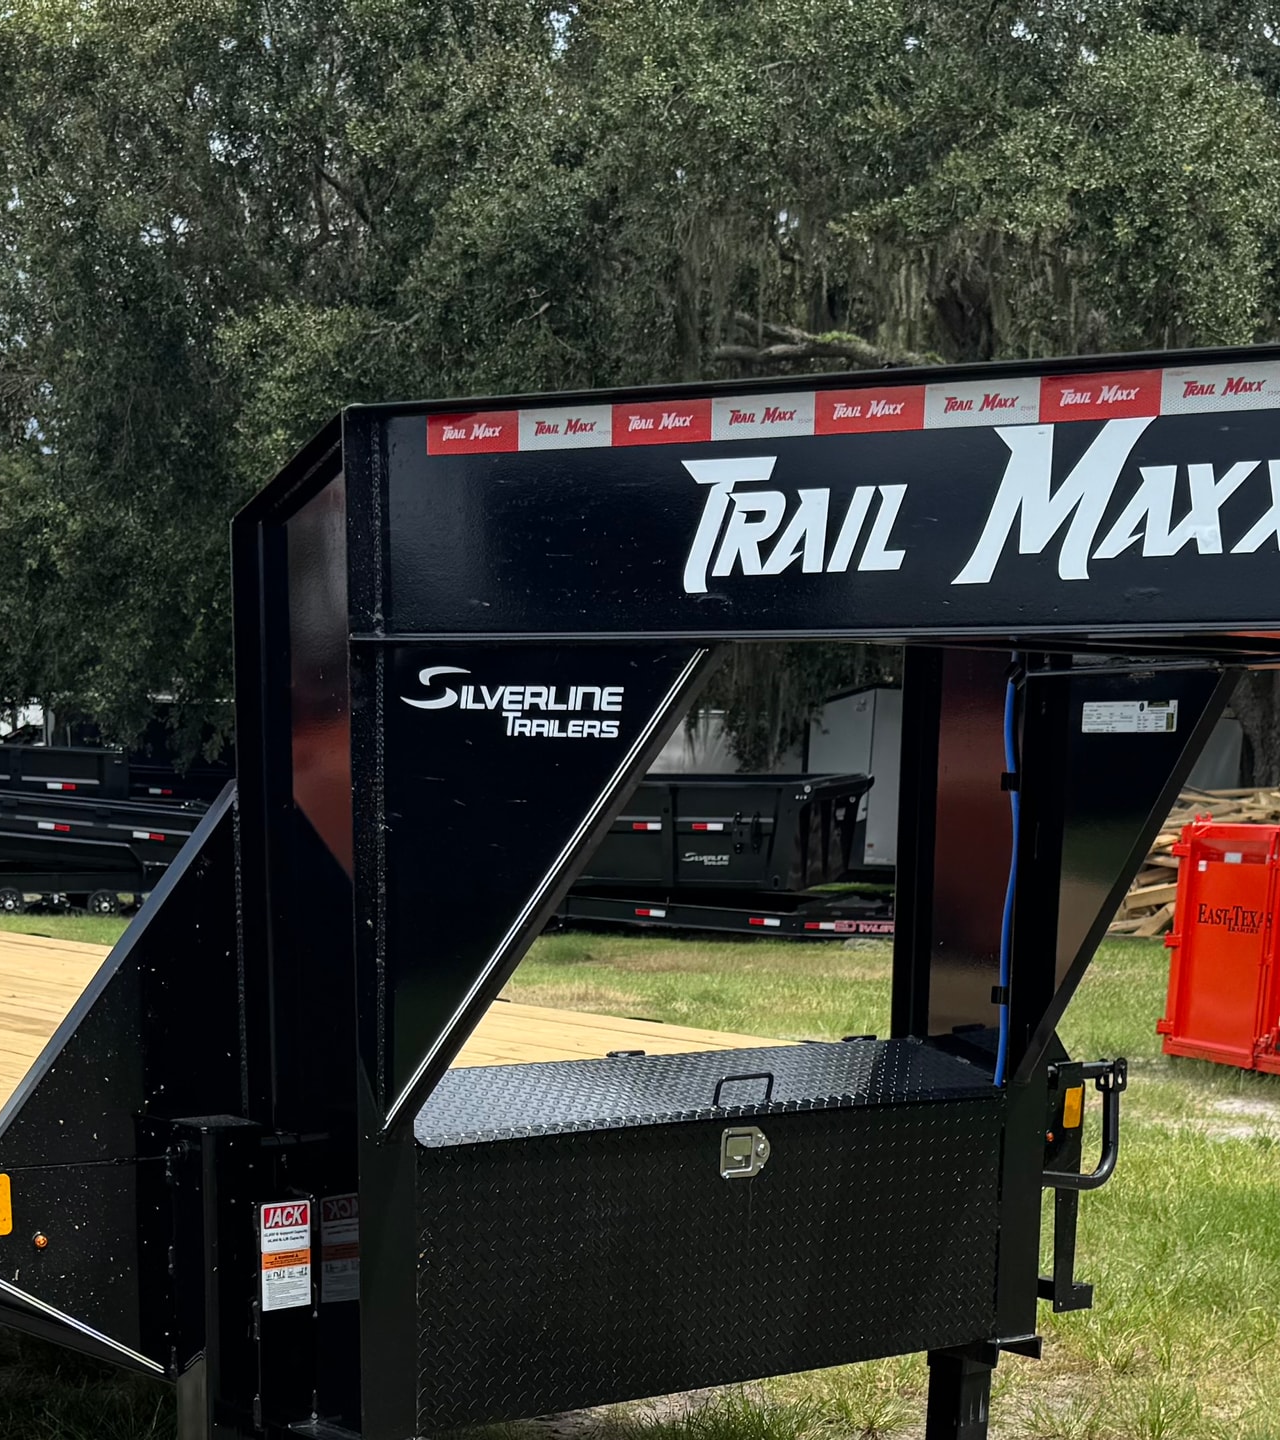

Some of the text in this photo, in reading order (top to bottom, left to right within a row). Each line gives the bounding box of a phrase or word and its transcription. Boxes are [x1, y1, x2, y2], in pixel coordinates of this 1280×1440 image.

[1059, 389, 1091, 407] TRAIL
[1096, 384, 1140, 404] MAXX
[1182, 376, 1267, 398] TRAIL MAXX
[832, 399, 905, 420] TRAIL MAXX
[943, 396, 974, 413] TRAIL
[978, 393, 1019, 412] MAXX
[628, 412, 694, 431] TRAIL MAXX
[728, 409, 756, 425] TRAIL
[760, 406, 797, 424] MAXX
[442, 423, 502, 441] TRAIL MAXX
[534, 418, 597, 436] TRAIL MAXX
[680, 455, 908, 594] TRAIL
[399, 665, 625, 712] SILVERLINE
[501, 711, 620, 738] TRAILERS
[1197, 903, 1230, 925] EAST
[265, 1204, 306, 1229] JACK
